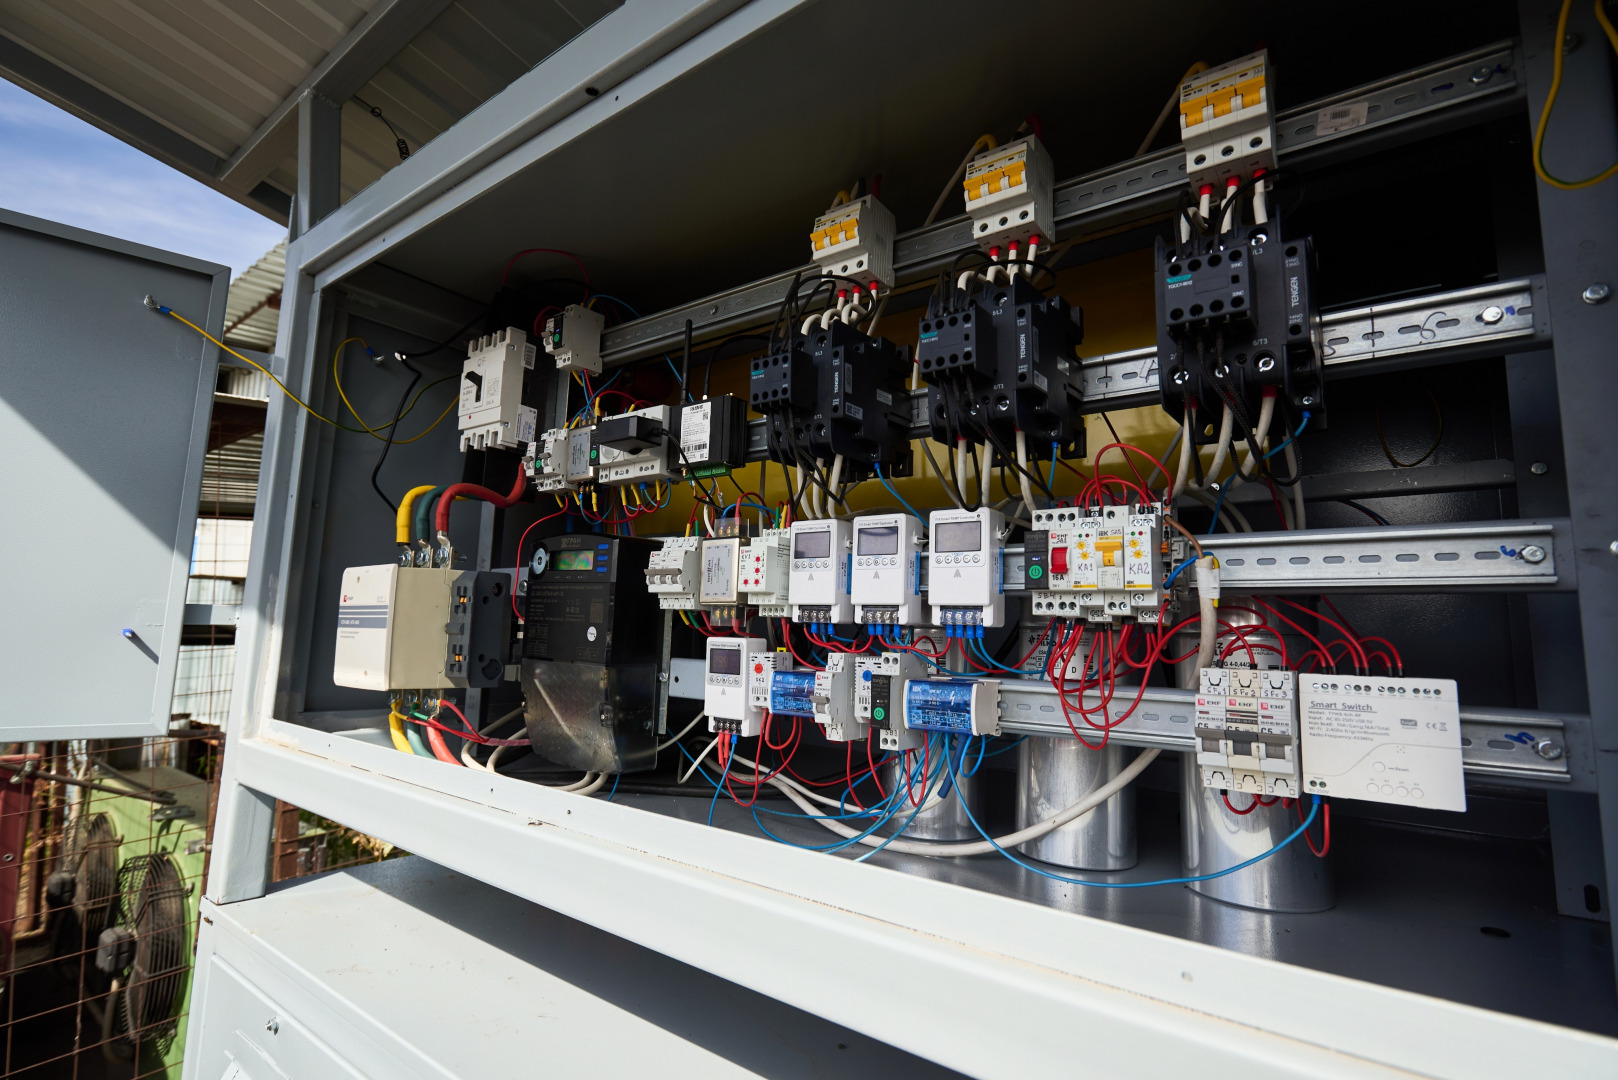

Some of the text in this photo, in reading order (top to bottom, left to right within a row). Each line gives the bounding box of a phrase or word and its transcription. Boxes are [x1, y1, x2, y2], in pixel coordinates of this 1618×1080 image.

[1291, 276, 1300, 308] TENGEN
[1077, 562, 1093, 571] KA1
[1128, 562, 1150, 575] KA2
[1071, 666, 1077, 674] D
[1310, 700, 1373, 711] Smart Switch
